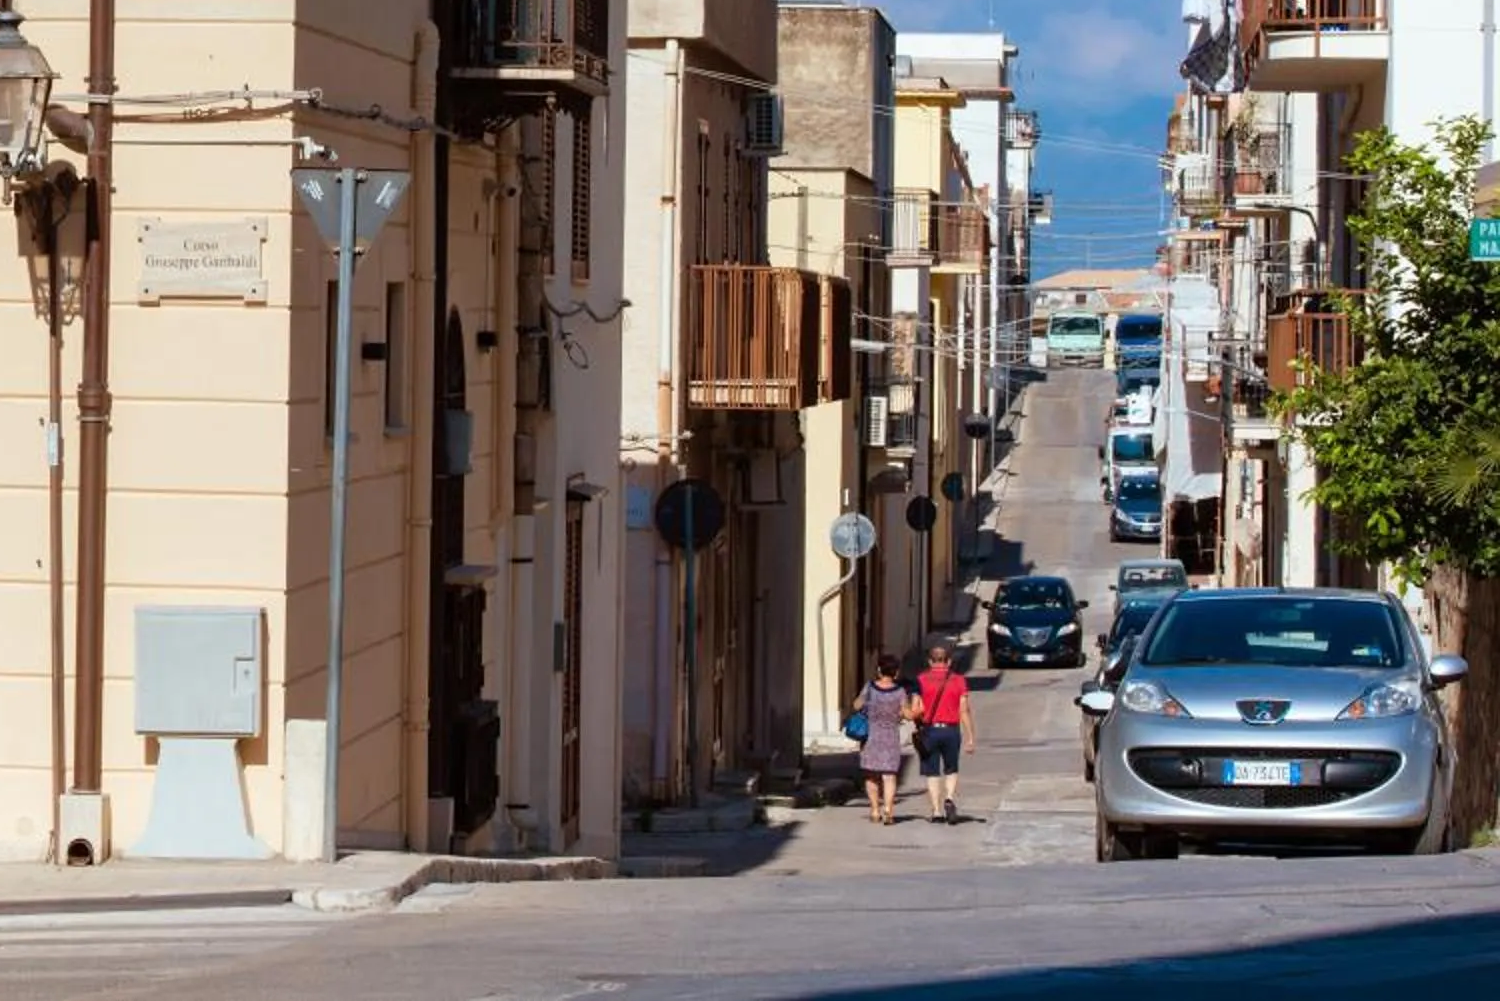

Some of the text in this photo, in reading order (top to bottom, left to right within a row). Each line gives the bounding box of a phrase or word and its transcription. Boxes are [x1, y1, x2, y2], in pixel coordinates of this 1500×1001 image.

[1479, 222, 1500, 236] PA
[183, 240, 219, 251] Corso
[145, 254, 257, 270] Giuseppe Garibaldi
